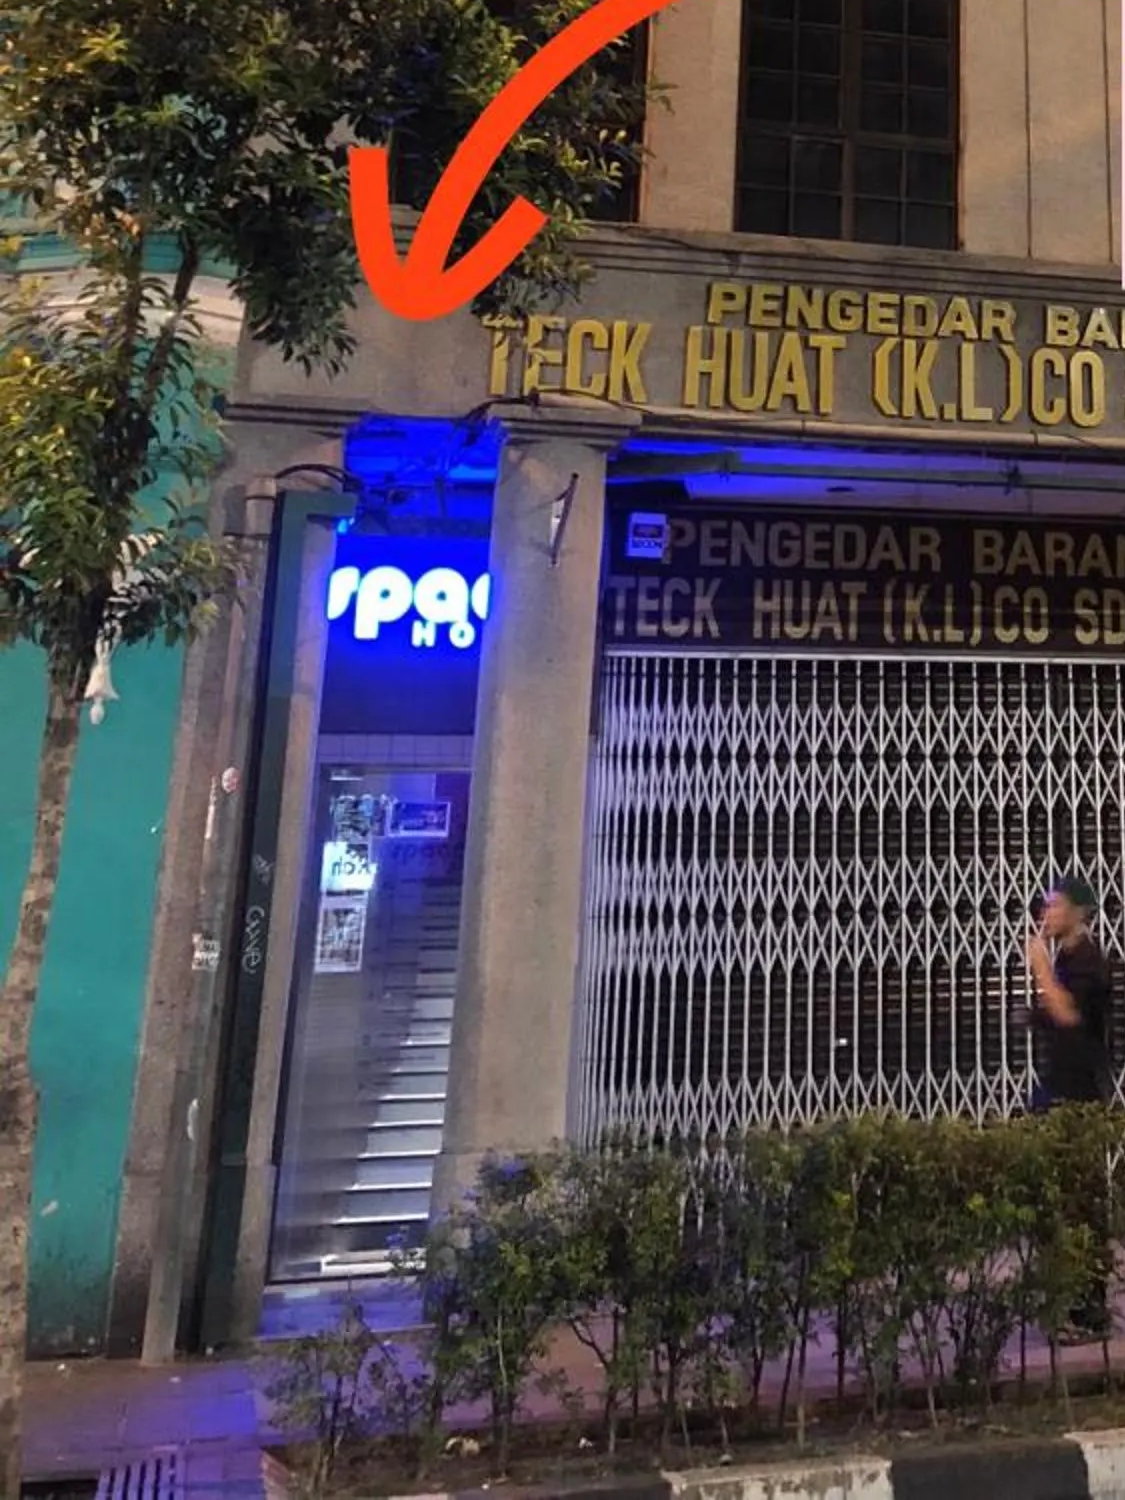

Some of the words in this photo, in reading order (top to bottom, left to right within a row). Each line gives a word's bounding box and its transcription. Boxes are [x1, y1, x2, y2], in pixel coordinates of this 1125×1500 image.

[708, 282, 1017, 343] PENGEDAR
[482, 312, 652, 403] TECK
[684, 325, 846, 416] HUAT
[661, 519, 942, 573] PENGEDAR
[607, 574, 722, 639] TECK
[752, 577, 867, 643] HUAT
